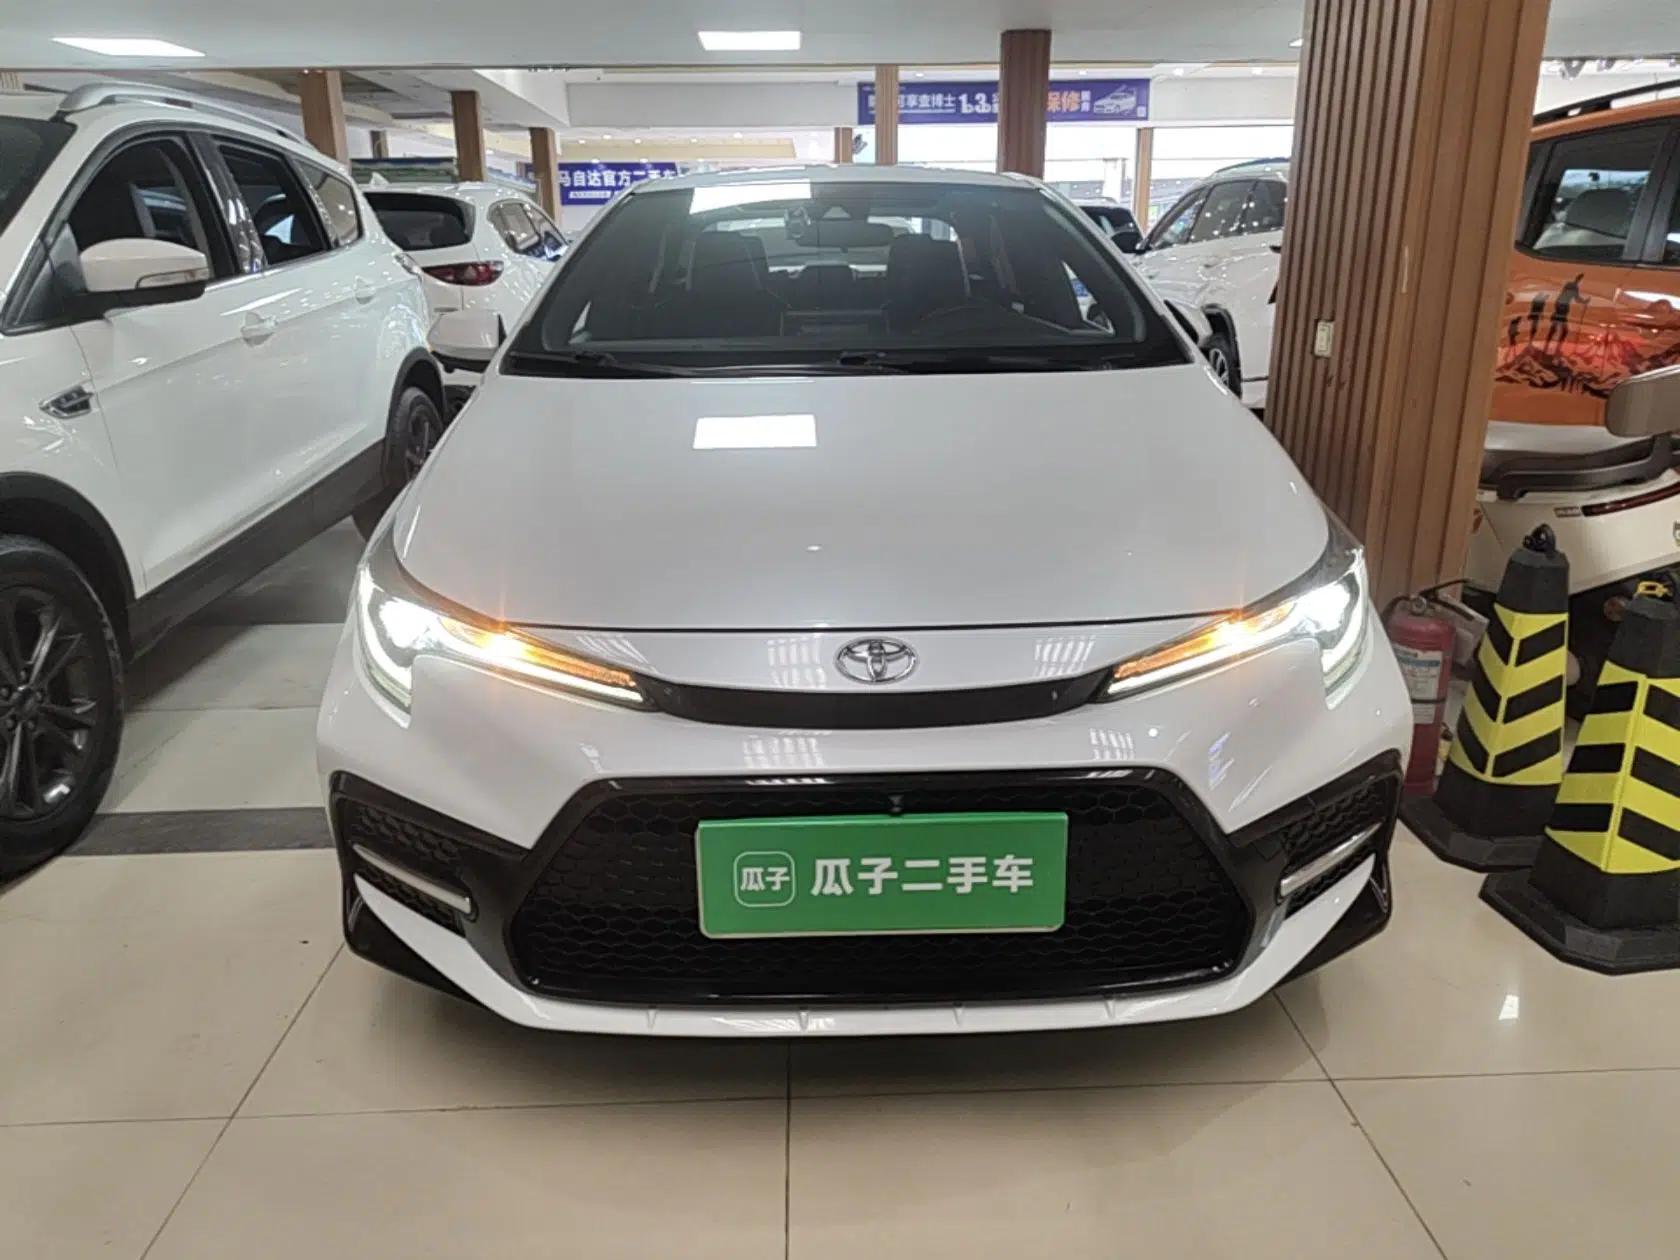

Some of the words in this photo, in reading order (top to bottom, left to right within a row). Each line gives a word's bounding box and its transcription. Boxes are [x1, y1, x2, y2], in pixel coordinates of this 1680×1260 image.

[740, 866, 791, 892] 瓜子
[810, 854, 1034, 897] 瓜子二手车
